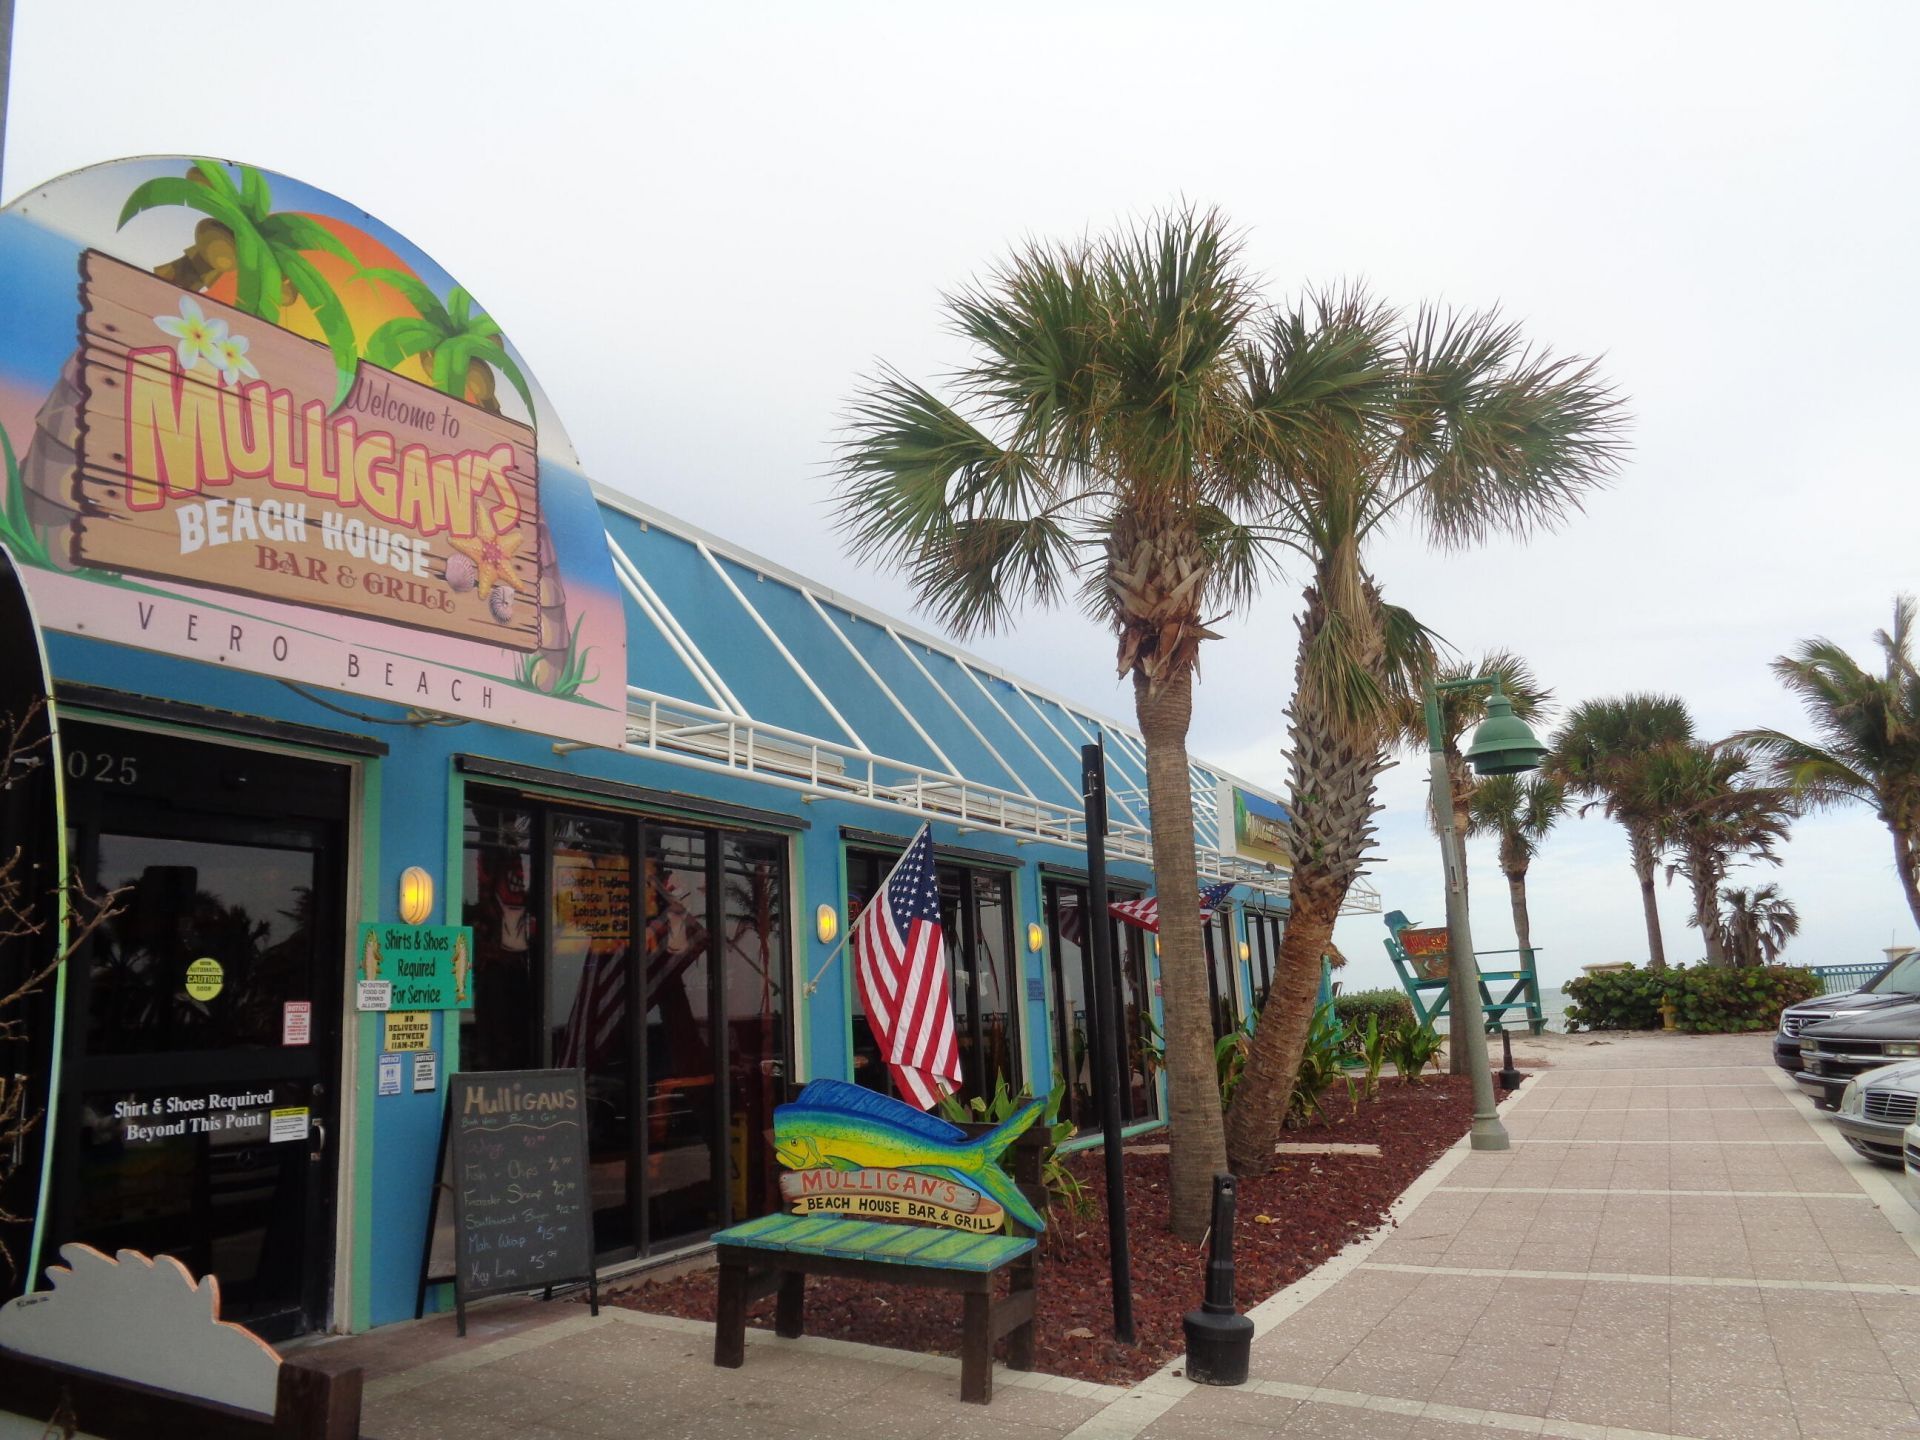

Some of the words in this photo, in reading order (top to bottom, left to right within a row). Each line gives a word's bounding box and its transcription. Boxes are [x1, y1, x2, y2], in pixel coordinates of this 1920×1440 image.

[343, 375, 434, 432] Welcome
[441, 406, 460, 439] to
[126, 345, 521, 537] MULLIGAN'S
[175, 497, 307, 556] BEACH
[321, 510, 431, 579] HOUSE
[255, 544, 329, 585] BAR
[337, 564, 358, 588] &
[363, 571, 456, 614] GRILL
[137, 600, 289, 662] VERO
[347, 653, 493, 709] BEACH
[385, 929, 411, 951] Shirts
[414, 930, 421, 950] &
[423, 930, 449, 951] Shoes
[187, 975, 222, 984] CAUTION
[397, 956, 436, 979] Required
[391, 985, 406, 1003] For
[408, 984, 441, 1004] Service
[388, 1023, 429, 1032] DELIVERIES
[392, 1032, 425, 1041] BETWEEN
[392, 1041, 424, 1049] 11AM-2PM
[114, 1101, 148, 1118] Shirt
[166, 1096, 205, 1114] Shoes
[208, 1089, 274, 1110] Required
[126, 1120, 185, 1142] Beyond
[189, 1115, 221, 1133] This
[225, 1112, 263, 1128] Point
[802, 1171, 957, 1204] MULLIGAN'S
[807, 1197, 850, 1213] BEACH
[859, 1198, 900, 1214] HOUSE
[908, 1202, 937, 1219] BAR
[940, 1210, 949, 1221] &
[954, 1212, 995, 1229] GRILL
